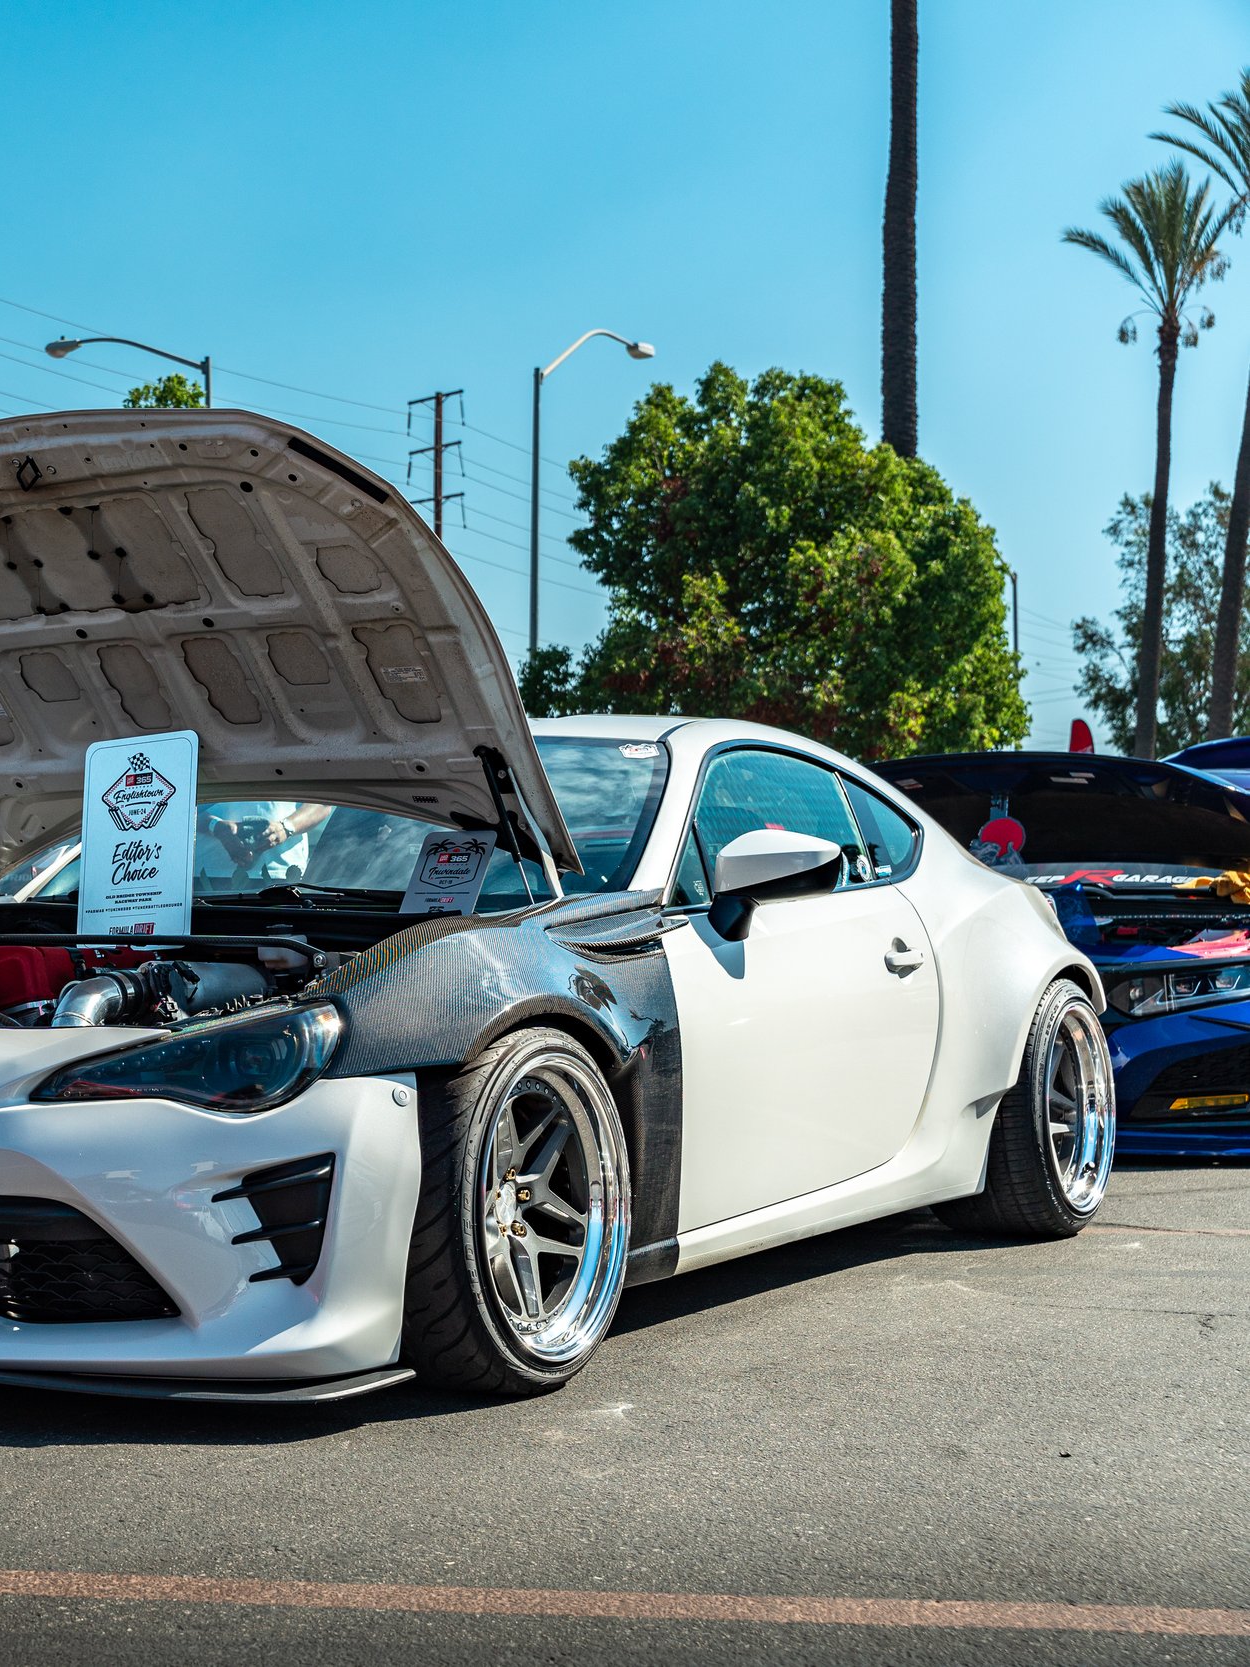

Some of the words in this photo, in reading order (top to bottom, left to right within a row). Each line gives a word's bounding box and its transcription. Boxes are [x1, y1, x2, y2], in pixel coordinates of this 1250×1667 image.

[136, 776, 152, 784] 365
[113, 788, 164, 804] Englishtown
[128, 807, 147, 816] JUNE-24
[112, 839, 162, 864] Editor's
[111, 861, 159, 886] Choice
[108, 925, 134, 935] FORMULA
[135, 924, 153, 933] DRIFT
